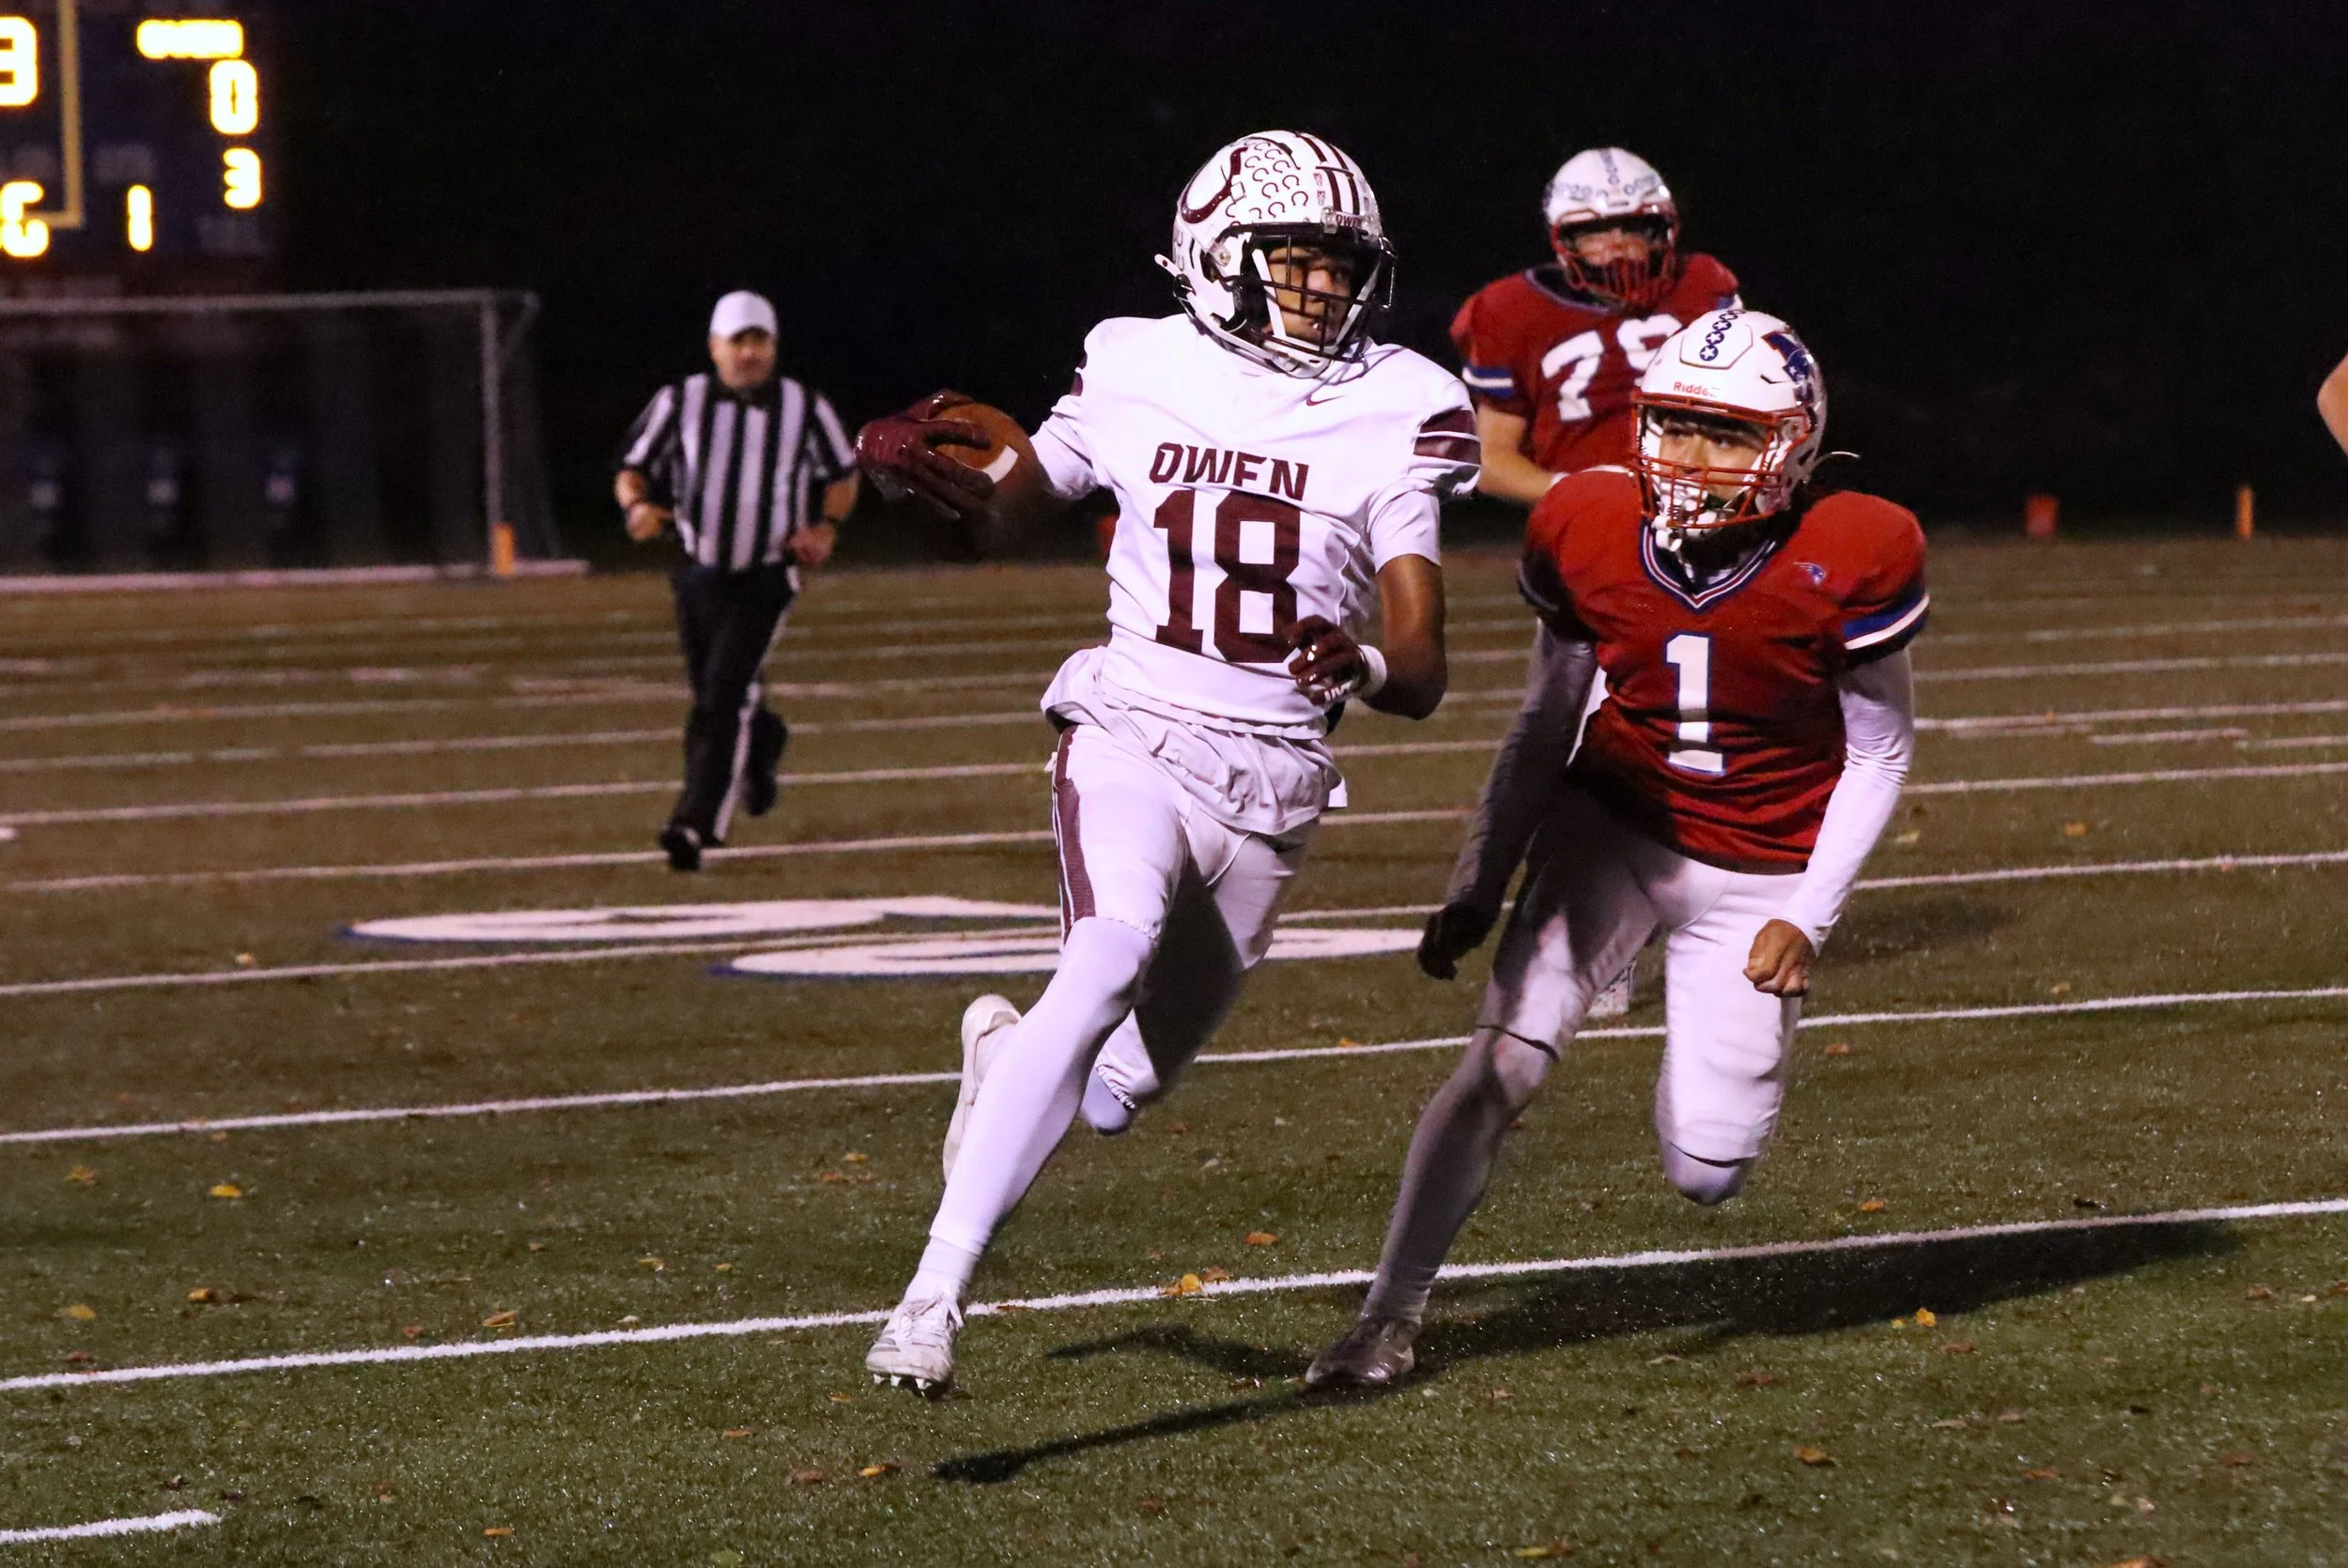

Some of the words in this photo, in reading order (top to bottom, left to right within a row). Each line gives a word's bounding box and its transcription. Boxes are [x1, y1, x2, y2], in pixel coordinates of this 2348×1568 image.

[209, 59, 258, 135] 0
[223, 147, 262, 209] 3
[1149, 441, 1309, 501] OWEN
[1153, 488, 1301, 664] 18
[1665, 633, 1724, 774] 1
